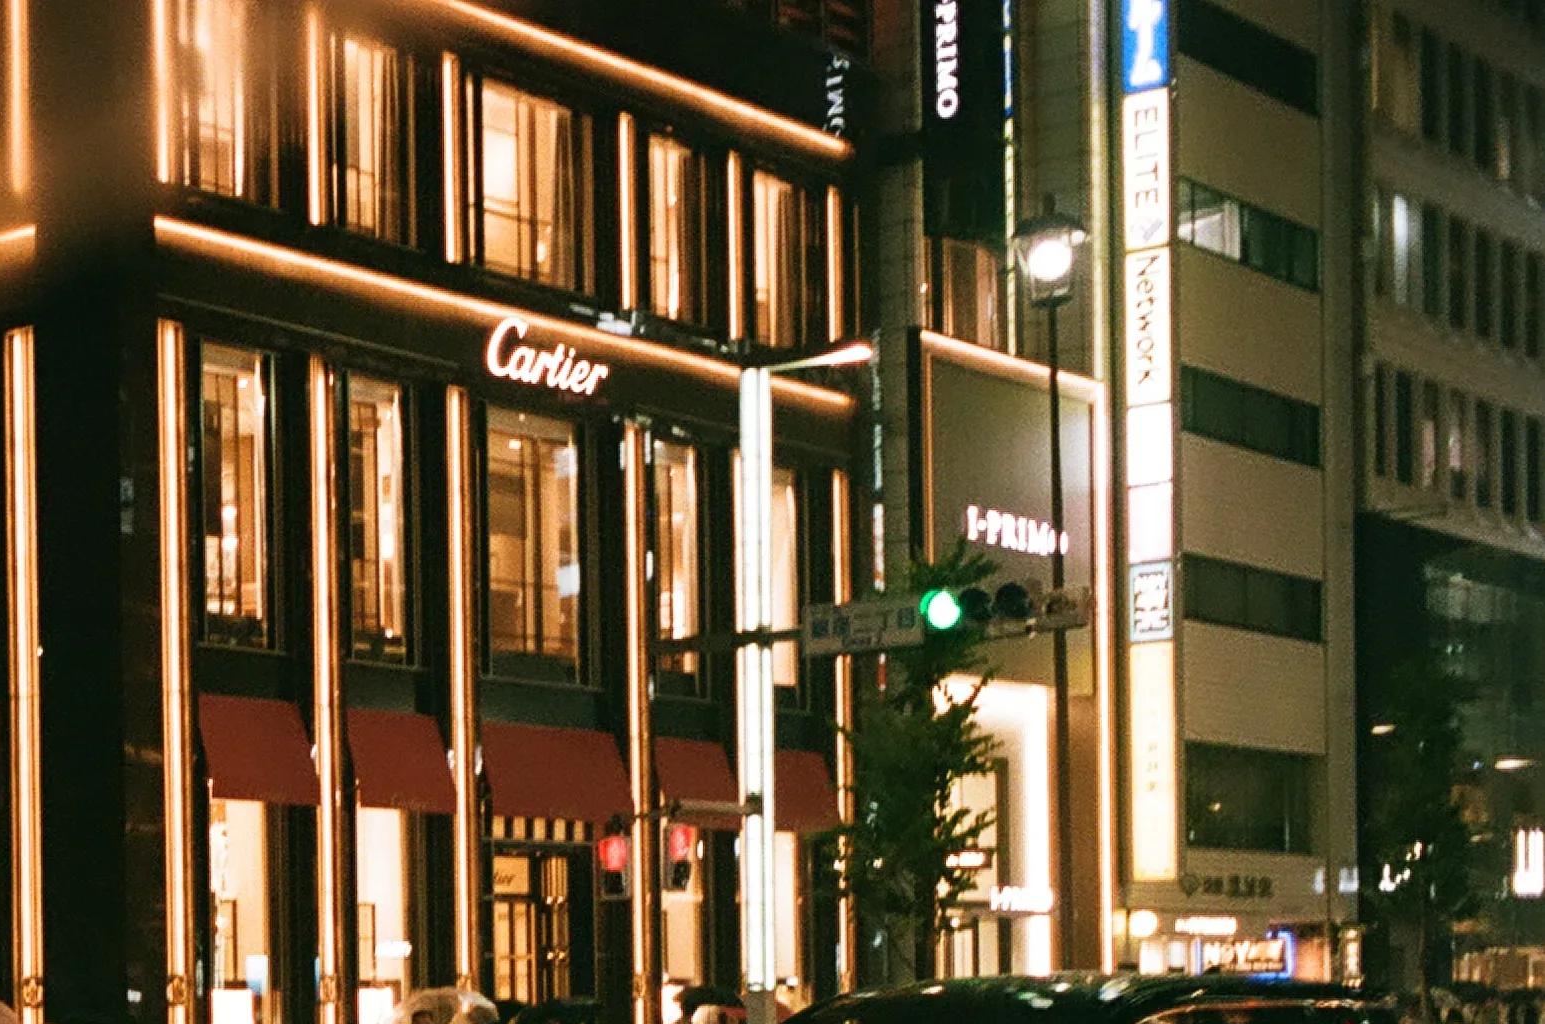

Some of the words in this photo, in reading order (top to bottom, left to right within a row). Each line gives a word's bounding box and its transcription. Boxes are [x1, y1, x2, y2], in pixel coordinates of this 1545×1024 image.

[935, 0, 958, 118] PRIMO
[1133, 105, 1160, 209] ELITE
[485, 316, 609, 396] Cartier
[1136, 254, 1161, 385] Network
